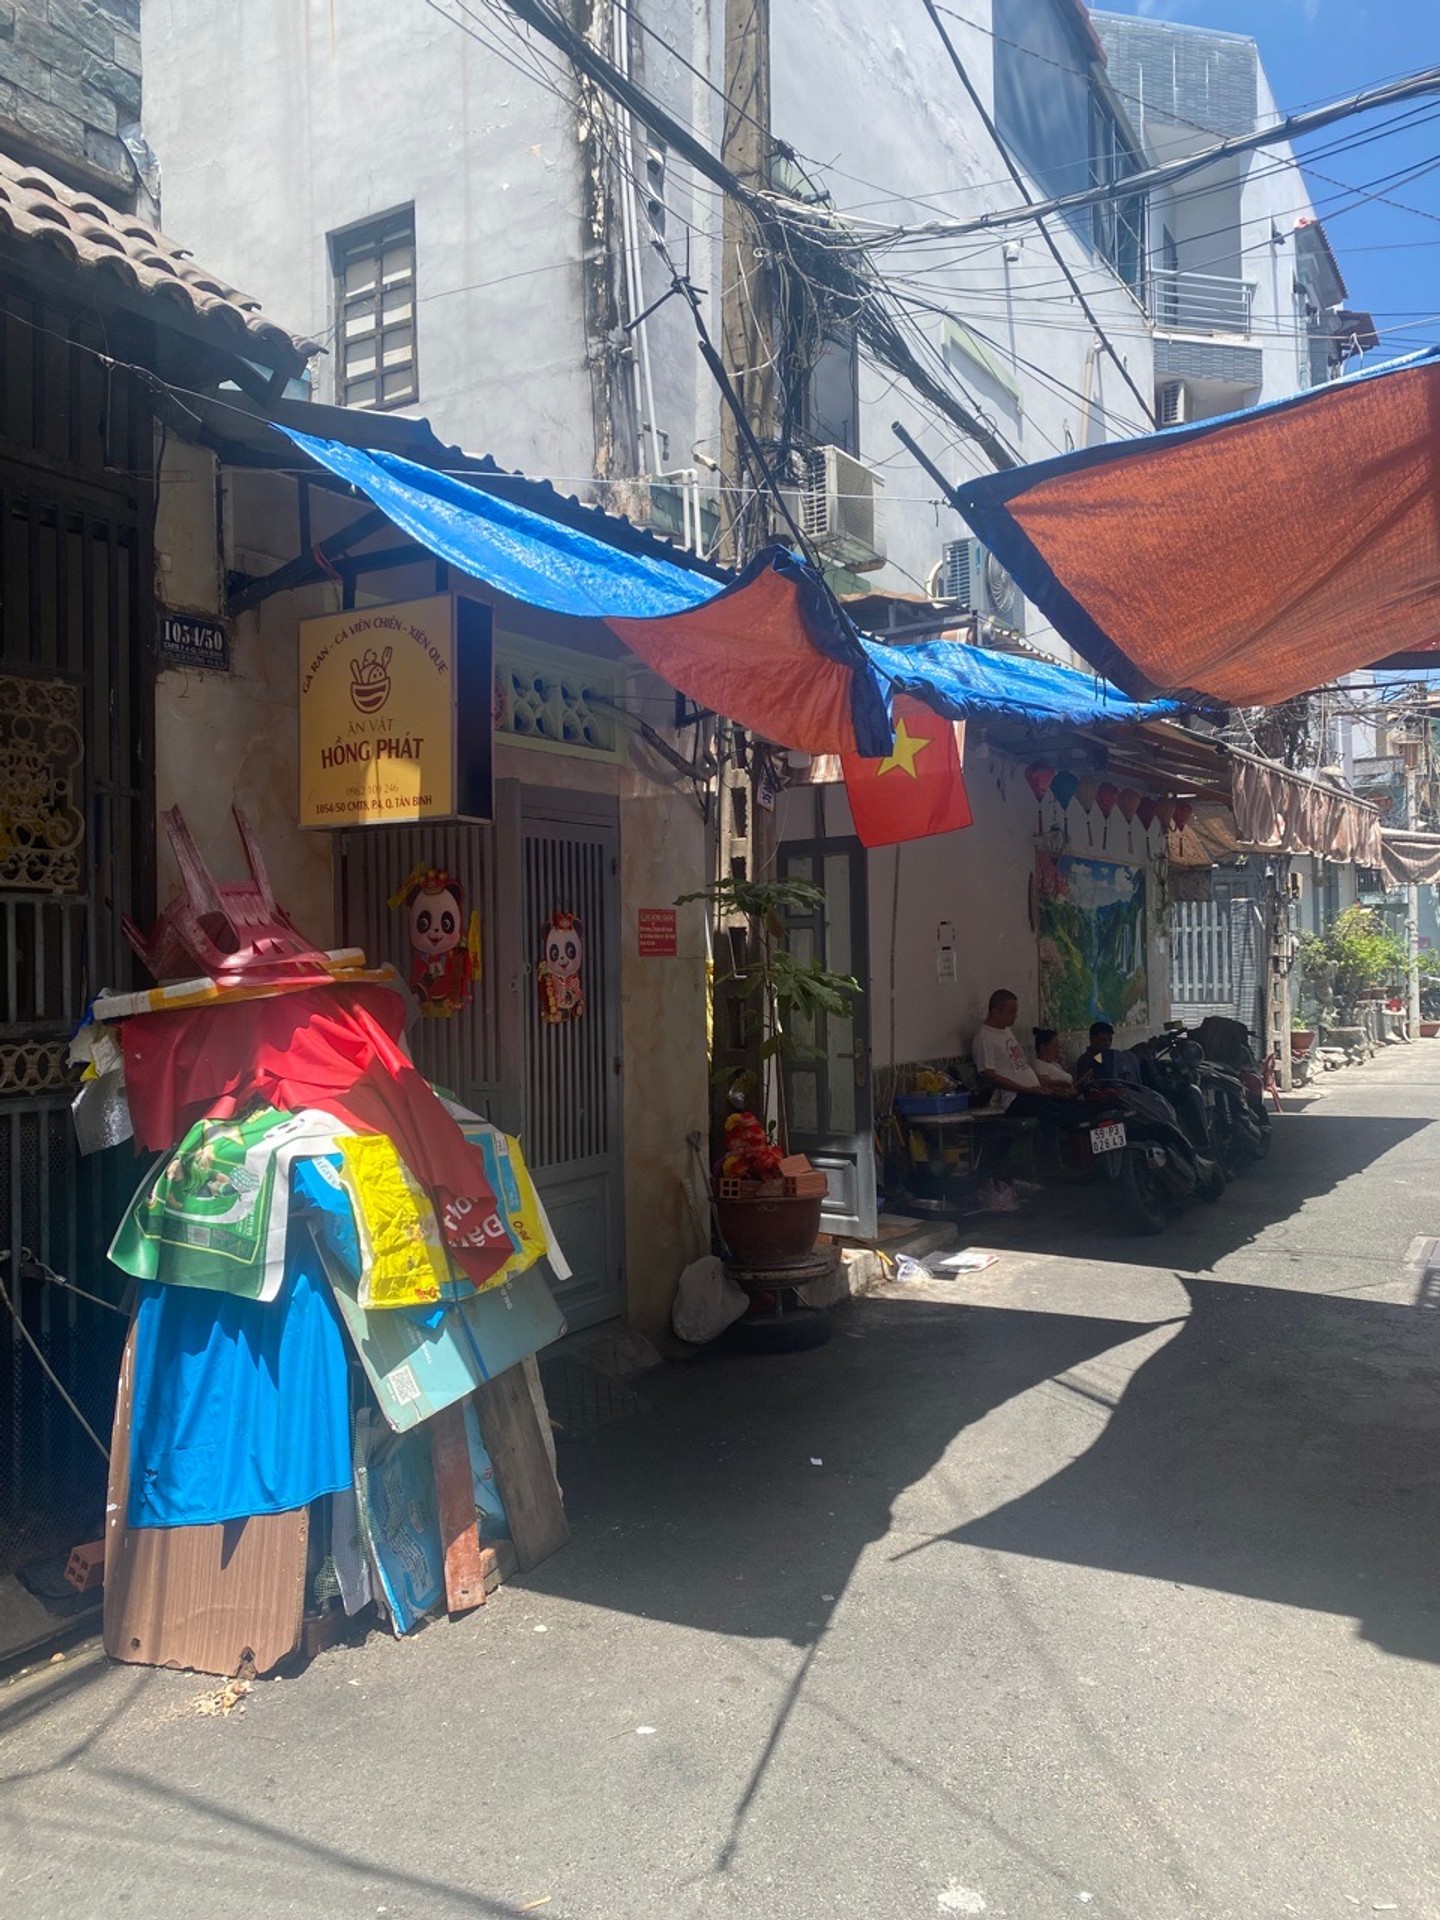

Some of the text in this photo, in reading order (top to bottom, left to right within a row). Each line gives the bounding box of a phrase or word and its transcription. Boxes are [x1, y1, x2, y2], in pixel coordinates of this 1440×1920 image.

[164, 621, 222, 651] 1054/50
[348, 618, 371, 635] VIÊN
[428, 646, 448, 675] QUE
[321, 731, 424, 769] HỒNG PHÁT
[395, 795, 411, 808] TÂN
[412, 794, 432, 807] BÌNH
